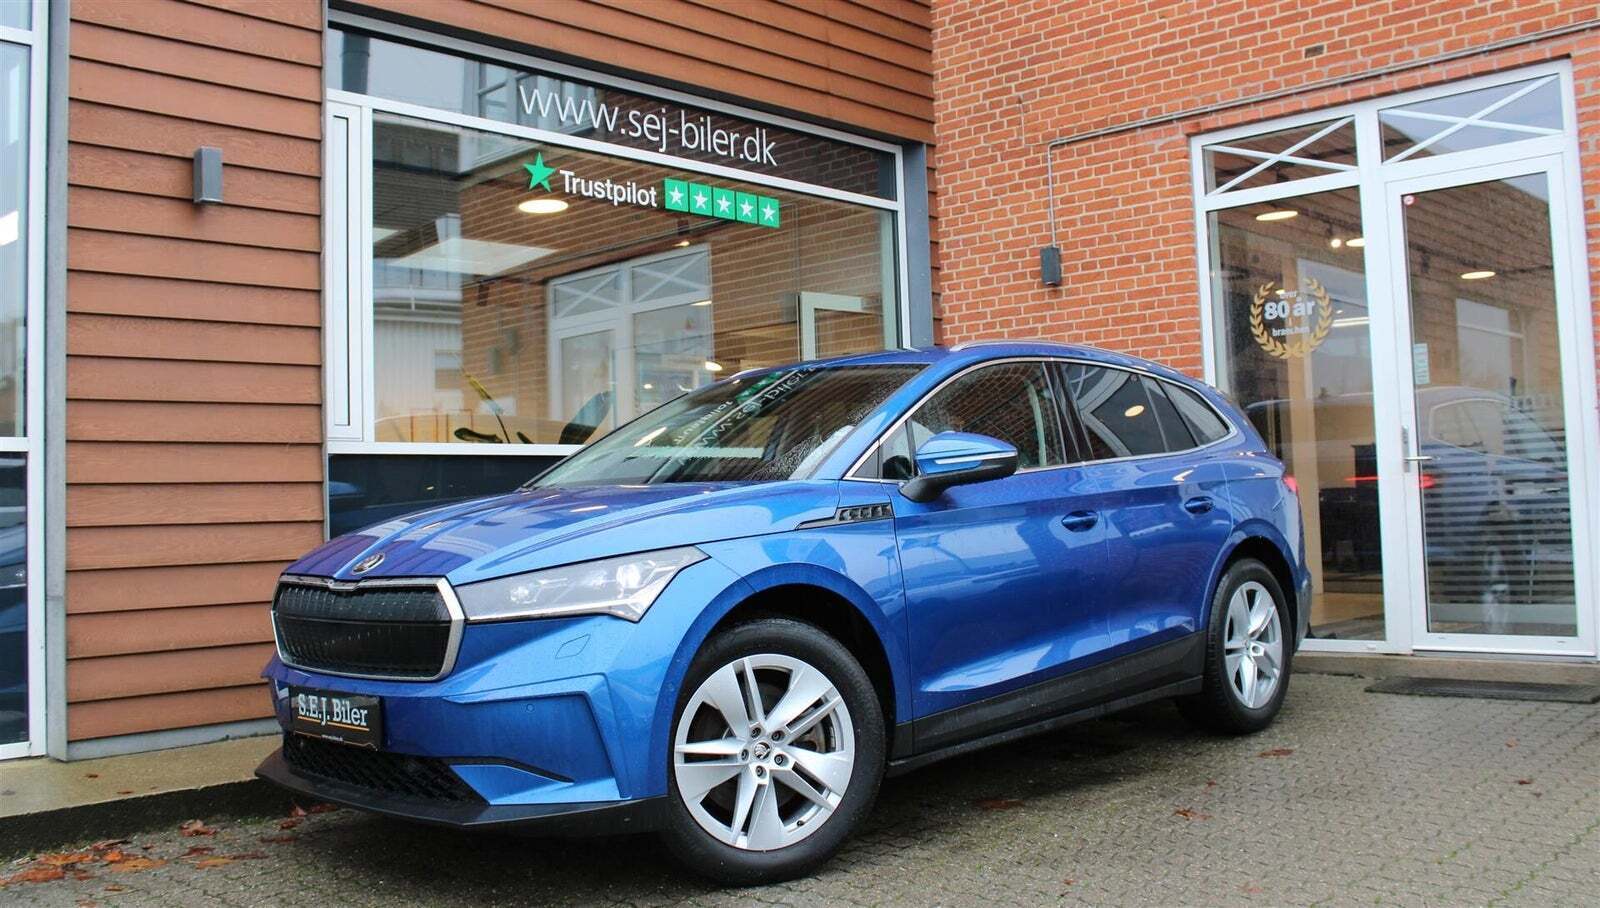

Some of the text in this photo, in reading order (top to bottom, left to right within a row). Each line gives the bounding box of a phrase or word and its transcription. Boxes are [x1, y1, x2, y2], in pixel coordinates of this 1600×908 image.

[519, 85, 778, 167] www.sej-biler.dk
[559, 169, 658, 208] Trustpilot
[1264, 297, 1315, 320] 80 år
[297, 693, 369, 727] S.E.J. Biler
